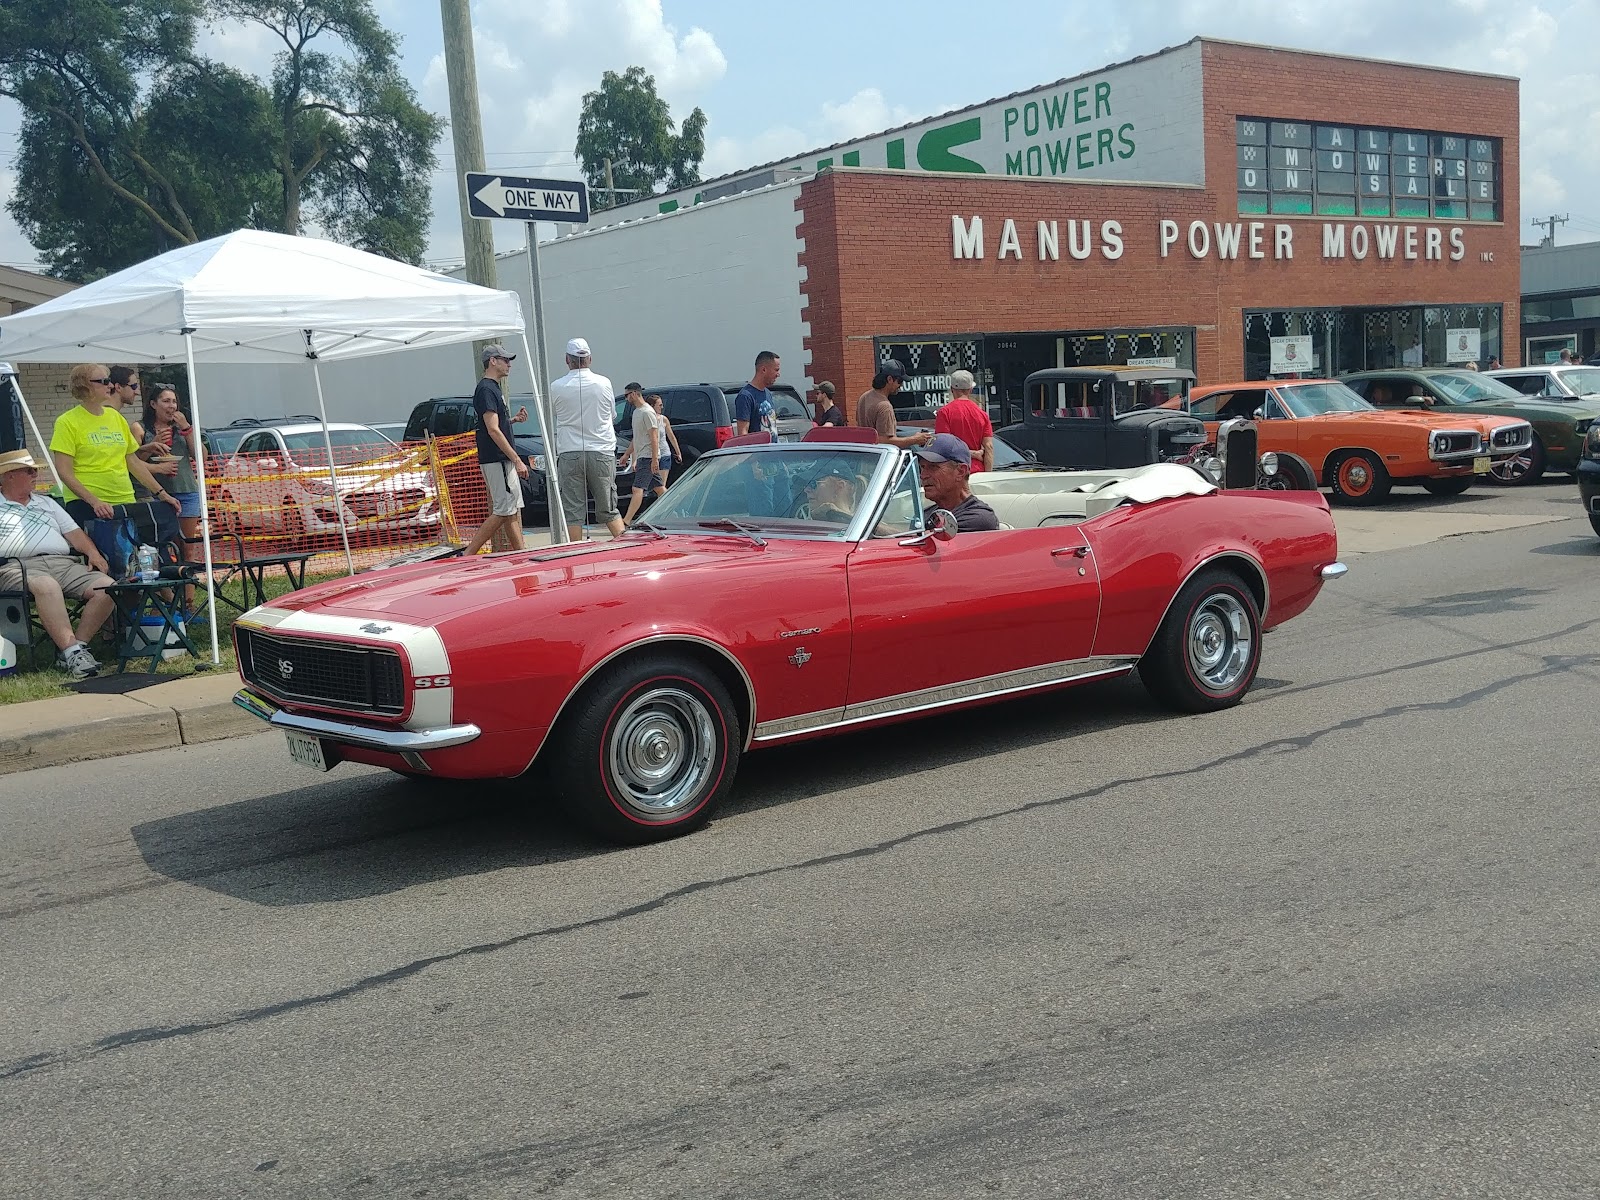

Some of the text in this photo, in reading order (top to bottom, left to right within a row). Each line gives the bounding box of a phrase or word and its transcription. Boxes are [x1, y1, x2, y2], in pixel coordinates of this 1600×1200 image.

[1004, 81, 1112, 142] POWER
[1005, 123, 1136, 176] MOWERS
[1331, 128, 1415, 151] ALL
[1285, 148, 1465, 177] MOWERS
[1244, 168, 1488, 198] ON SALE
[505, 190, 574, 209] ONE WAY
[952, 215, 1494, 262] MANUS POWER MOWERS INC
[924, 393, 949, 407] SALE
[414, 676, 451, 688] SS
